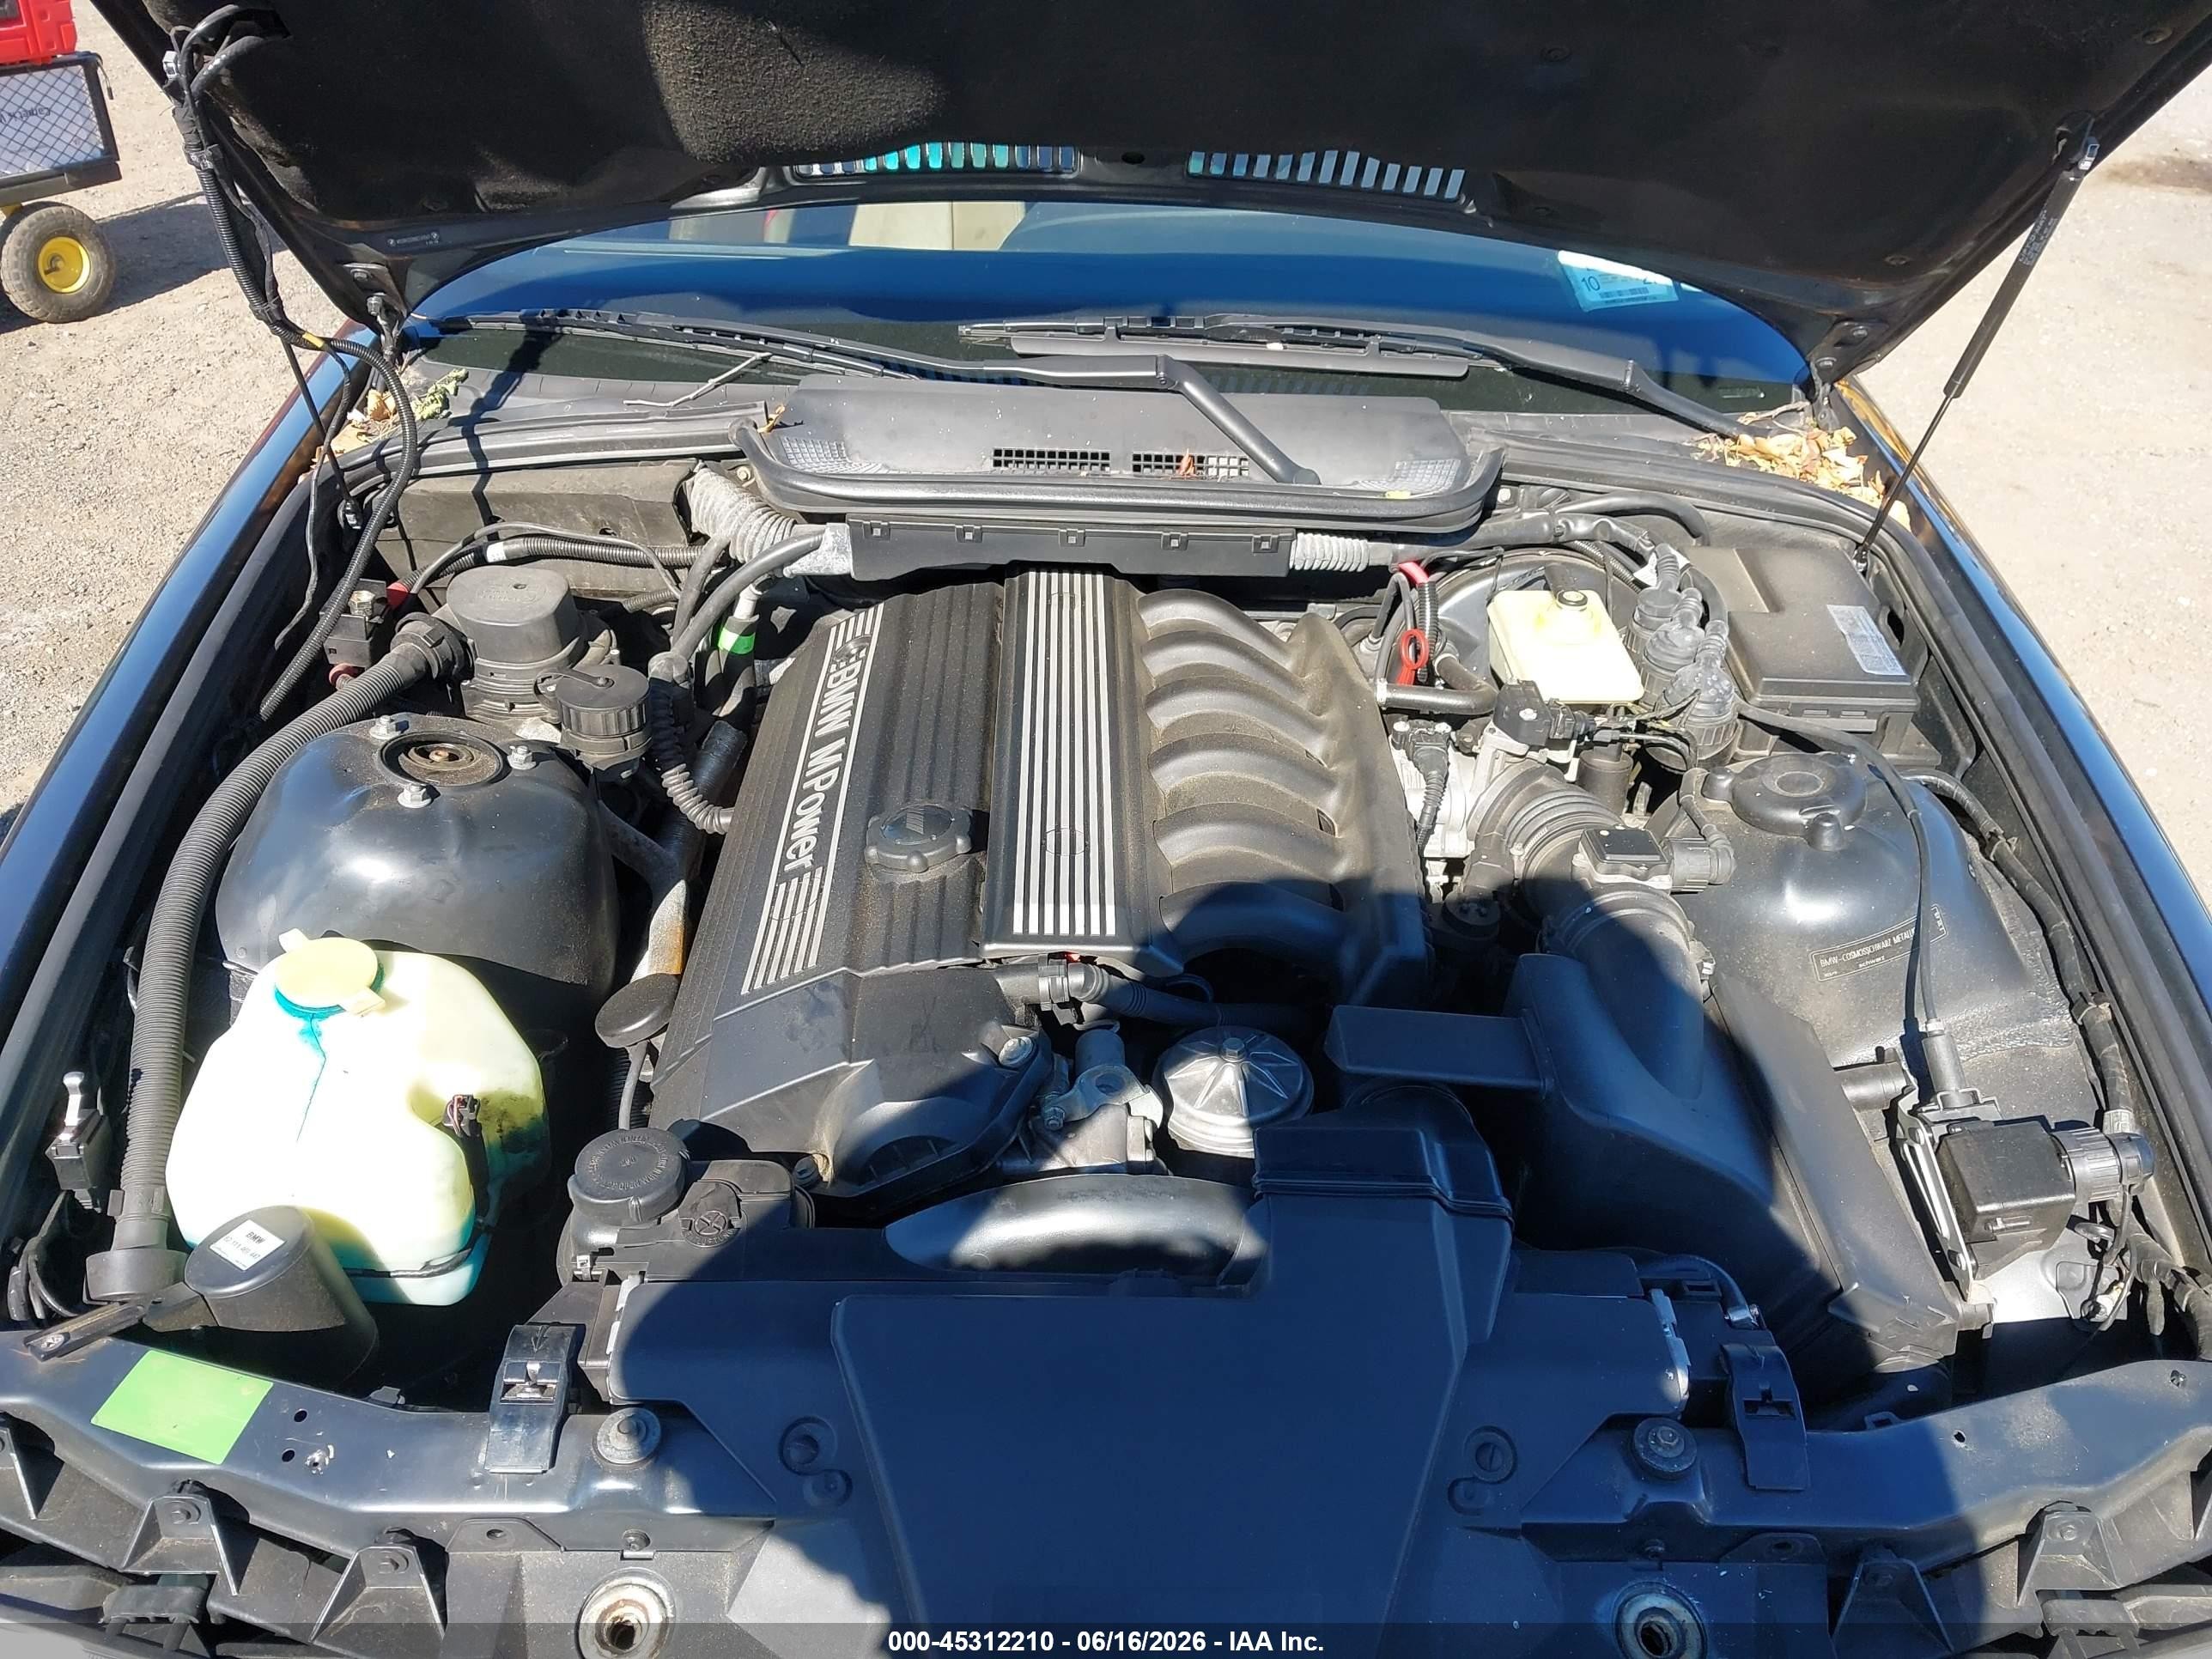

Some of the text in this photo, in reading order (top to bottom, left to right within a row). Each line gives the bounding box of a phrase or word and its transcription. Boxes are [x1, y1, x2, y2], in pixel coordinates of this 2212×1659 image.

[1582, 276, 1601, 292] 10
[815, 659, 862, 738] BMW
[246, 1231, 266, 1244] BMW
